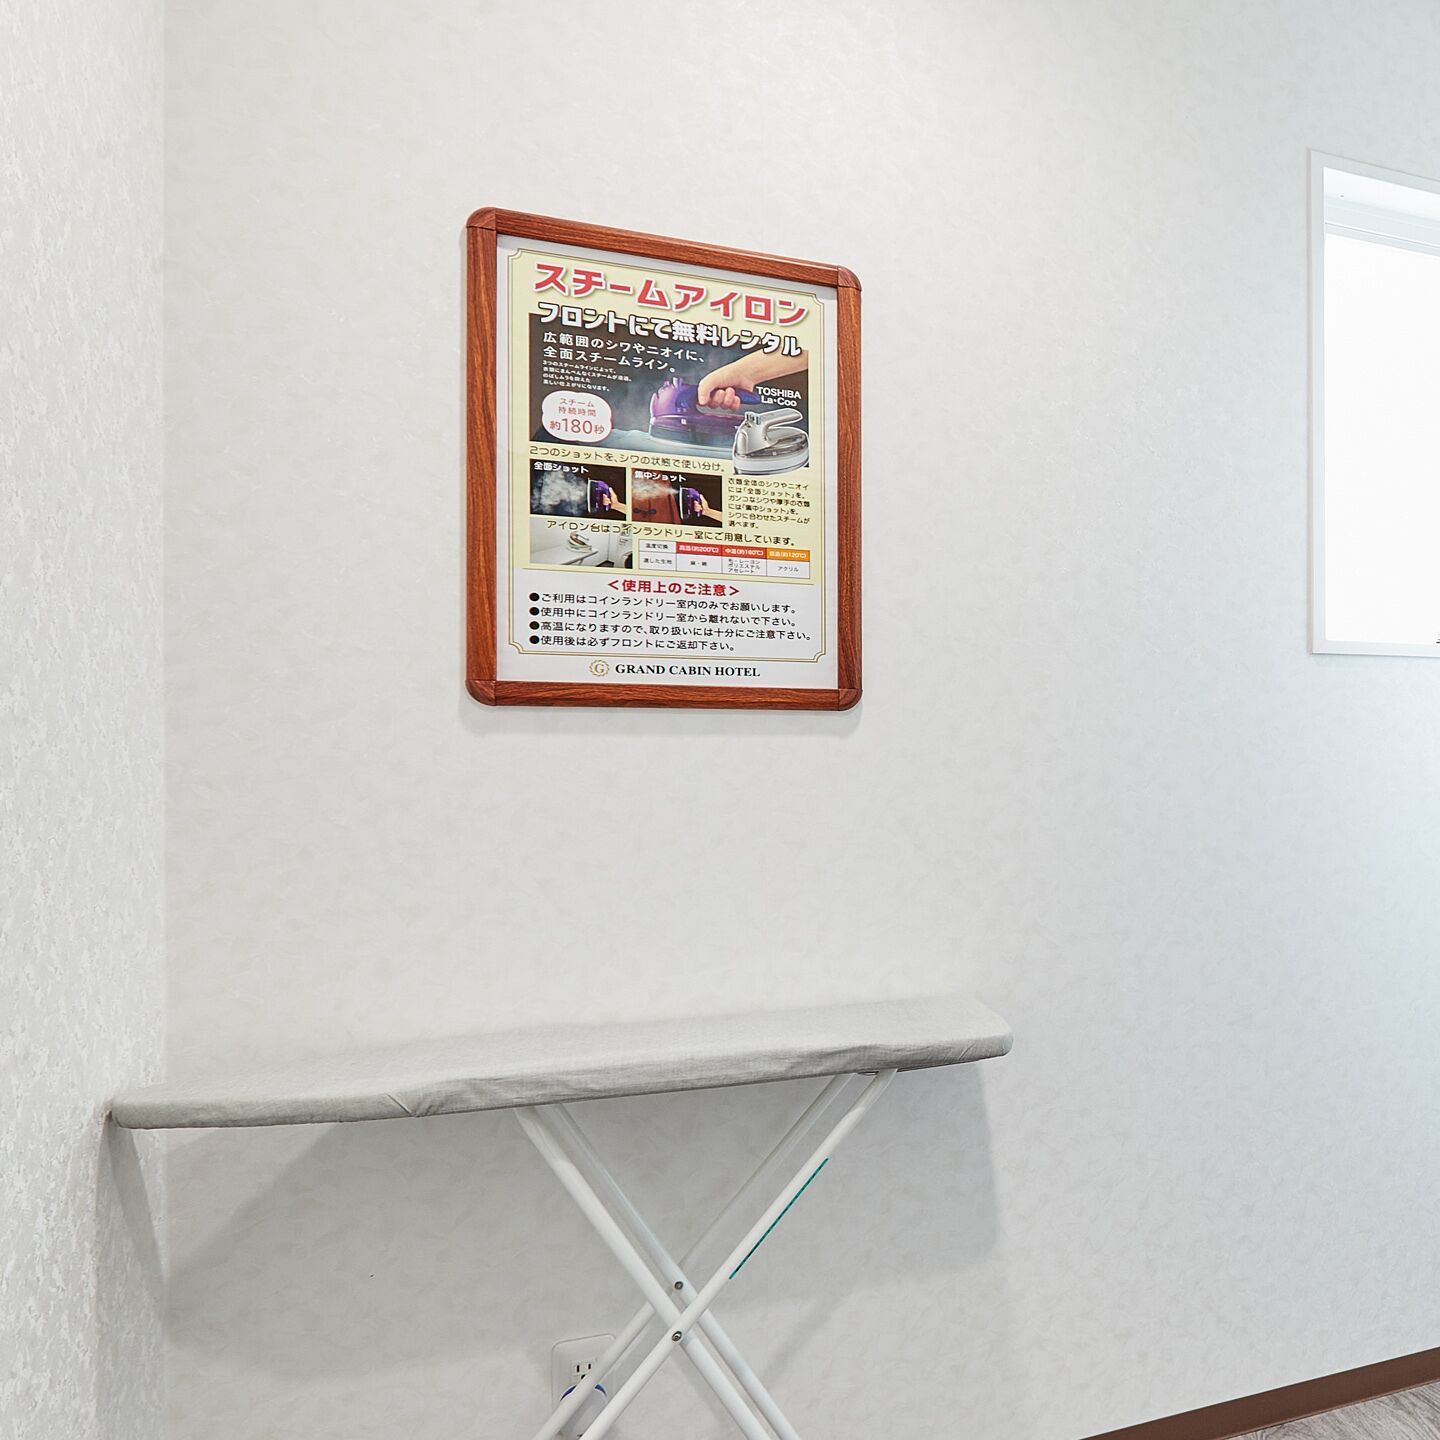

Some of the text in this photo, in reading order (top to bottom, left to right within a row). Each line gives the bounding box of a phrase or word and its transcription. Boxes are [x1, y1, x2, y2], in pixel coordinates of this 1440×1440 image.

[534, 263, 807, 324] スチームアイロン
[538, 302, 802, 356] フロントにて無料レンタル
[543, 332, 704, 363] 広範囲のシワやニオイに、
[543, 346, 675, 373] 全面スチームライン。
[756, 387, 801, 400] TOSHIBA
[560, 398, 594, 407] スチーム
[558, 406, 596, 417] 持続時間
[550, 418, 605, 434] 約180秒
[615, 664, 760, 677] GRAND CABIN HOTEL
